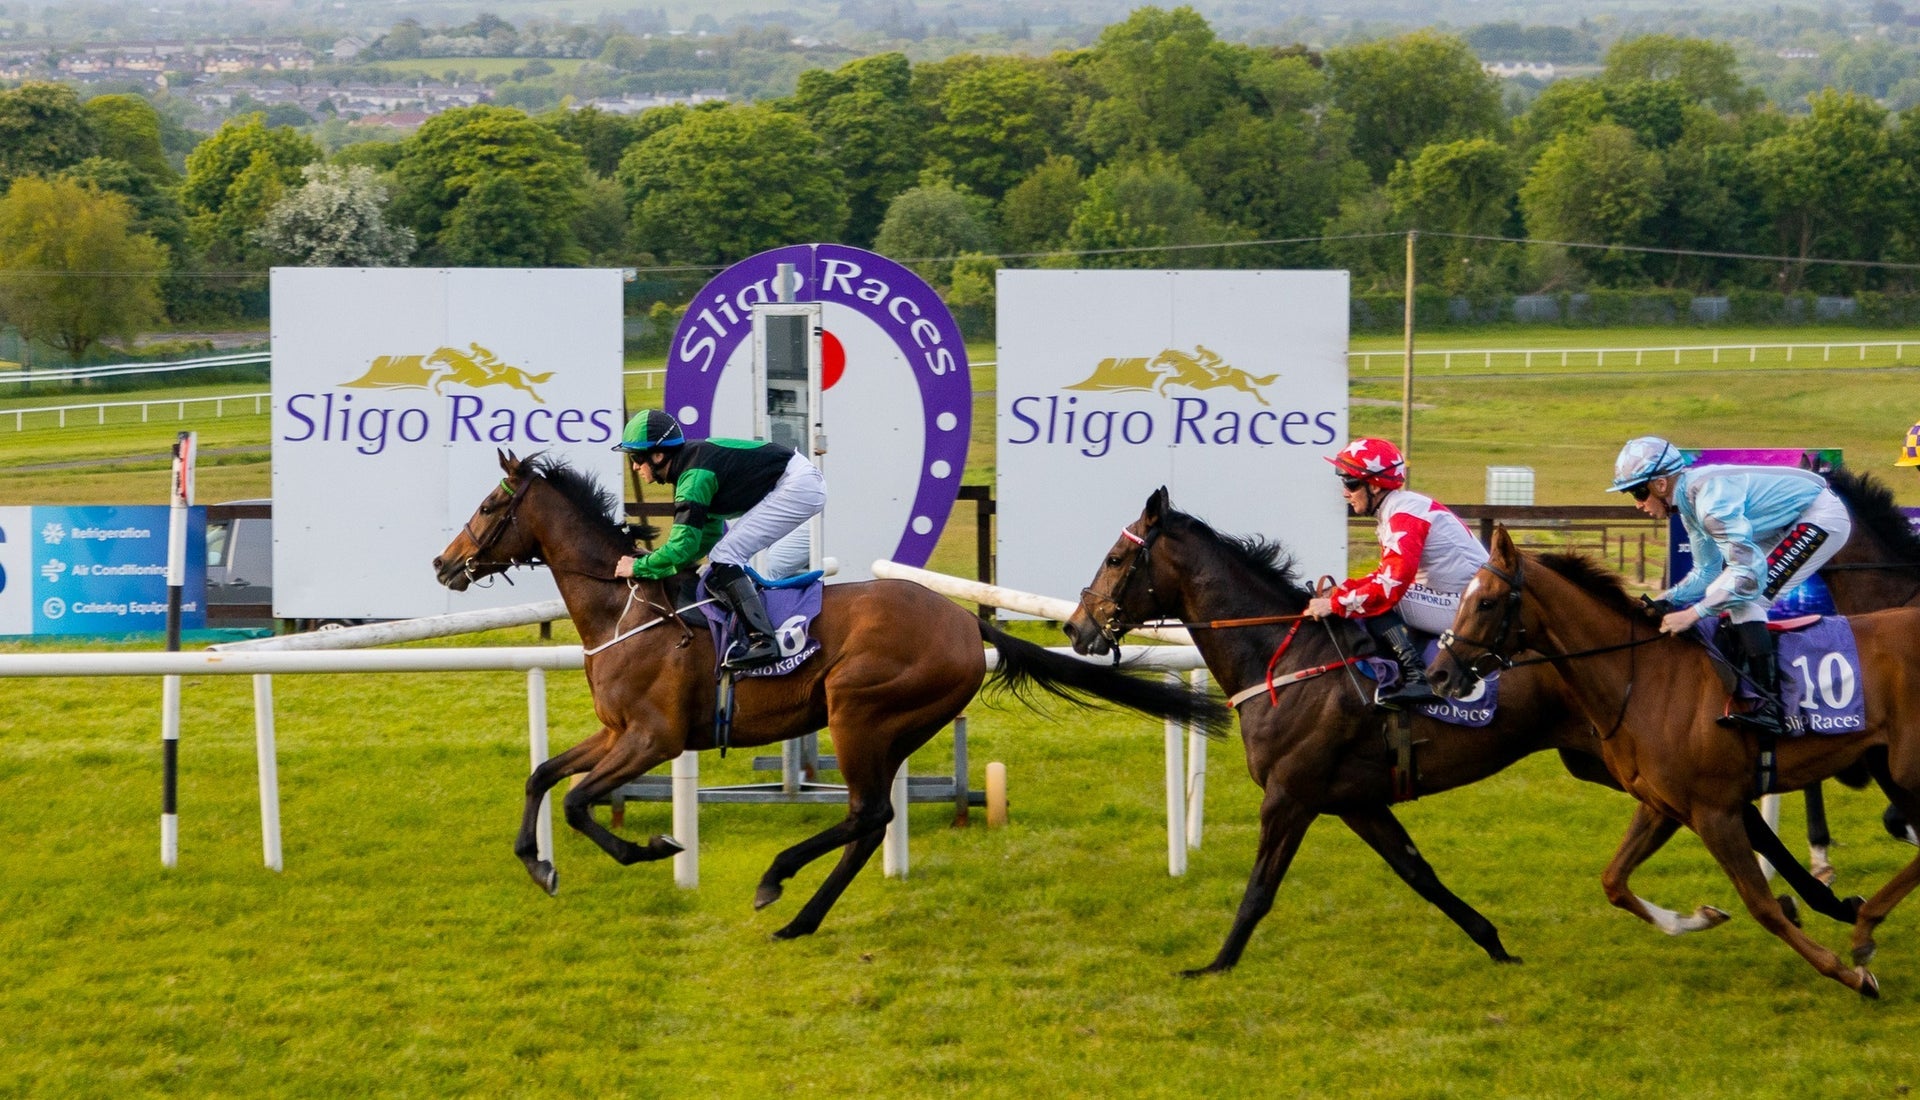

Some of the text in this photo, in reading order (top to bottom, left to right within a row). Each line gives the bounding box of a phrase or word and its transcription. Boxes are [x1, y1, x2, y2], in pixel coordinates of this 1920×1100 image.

[679, 258, 957, 376] Sligo Races
[284, 393, 429, 455] Sligo
[446, 394, 613, 443] Races
[1008, 395, 1337, 457] Sligo Races
[71, 527, 151, 541] Refrigeration
[1766, 528, 1818, 585] ERMINGHAM
[71, 564, 169, 578] Air Conditioning
[72, 602, 128, 615] Catering
[774, 615, 807, 657] 6
[1792, 652, 1855, 710] 10
[1811, 713, 1860, 730] Races
